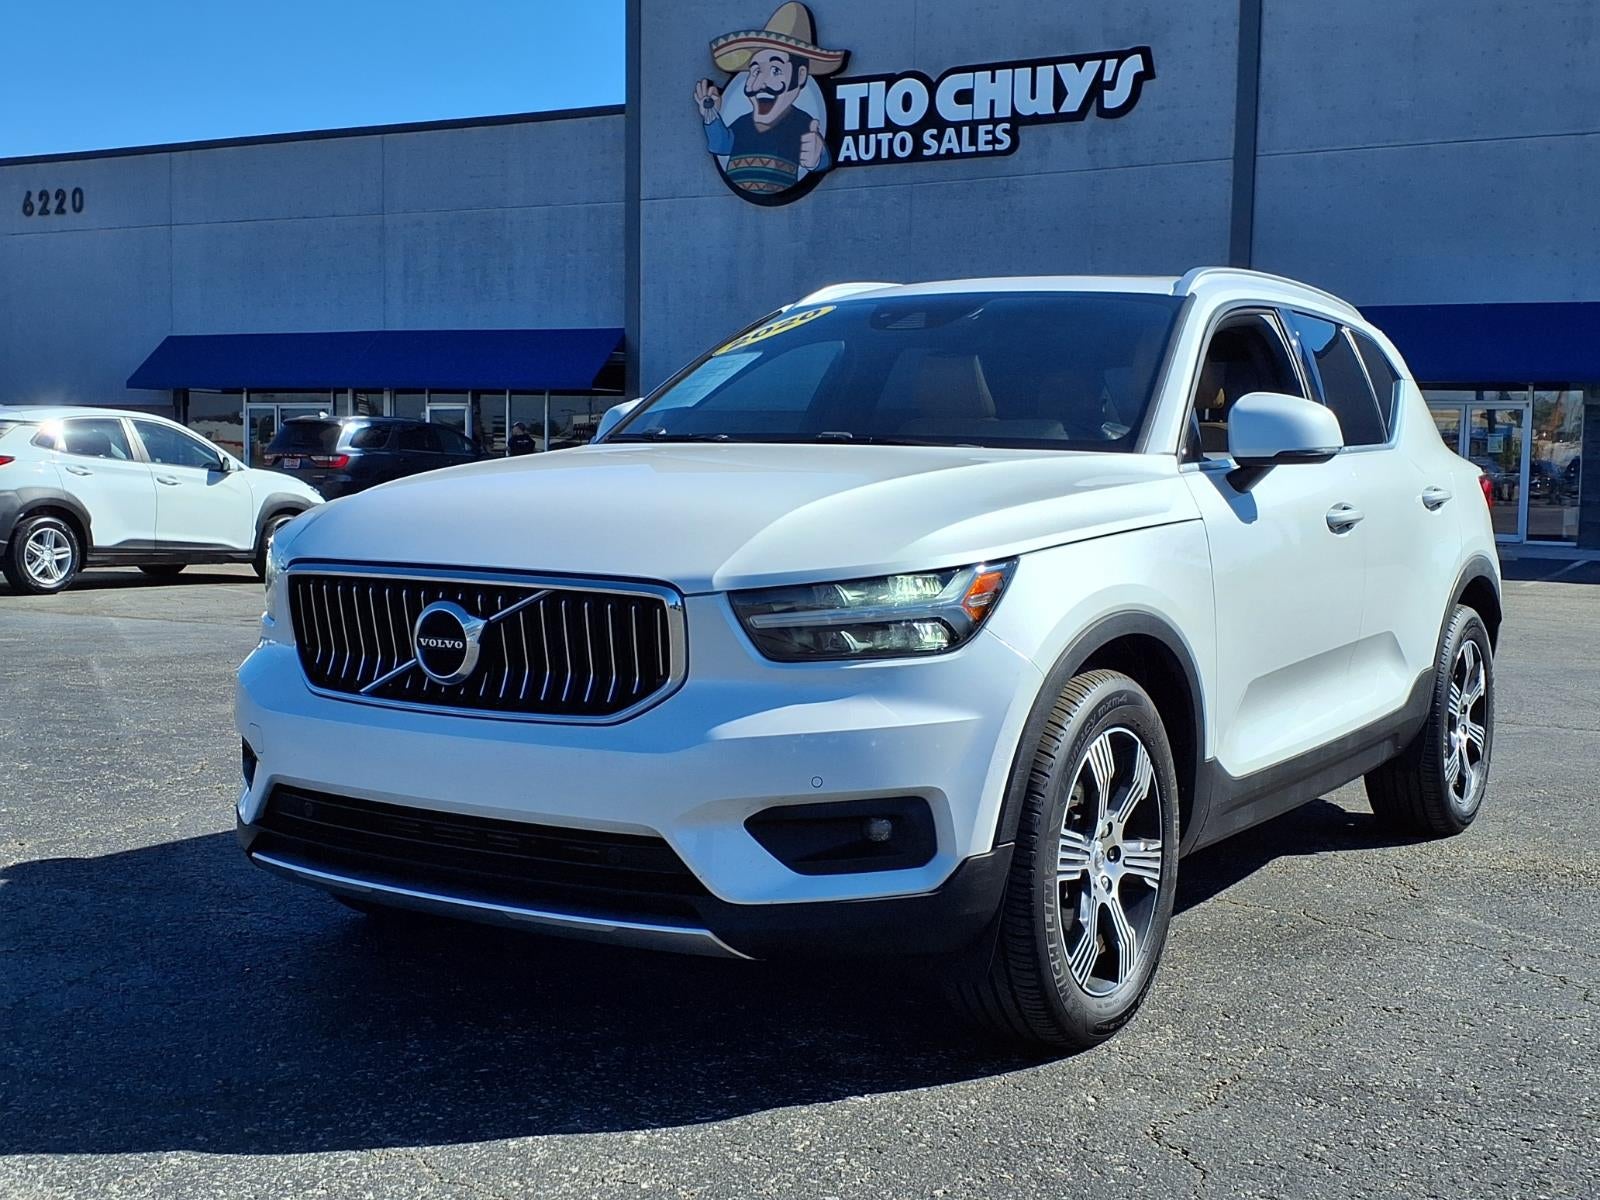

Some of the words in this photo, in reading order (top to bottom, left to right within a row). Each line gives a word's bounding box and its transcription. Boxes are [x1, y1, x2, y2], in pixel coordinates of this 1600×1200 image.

[836, 78, 930, 131] TIO
[936, 54, 1144, 122] CHUY'S
[838, 132, 914, 162] AUTO
[922, 124, 1012, 156] SALES
[22, 187, 84, 217] 6220
[729, 309, 822, 349] 2020
[419, 638, 463, 649] VOLVO
